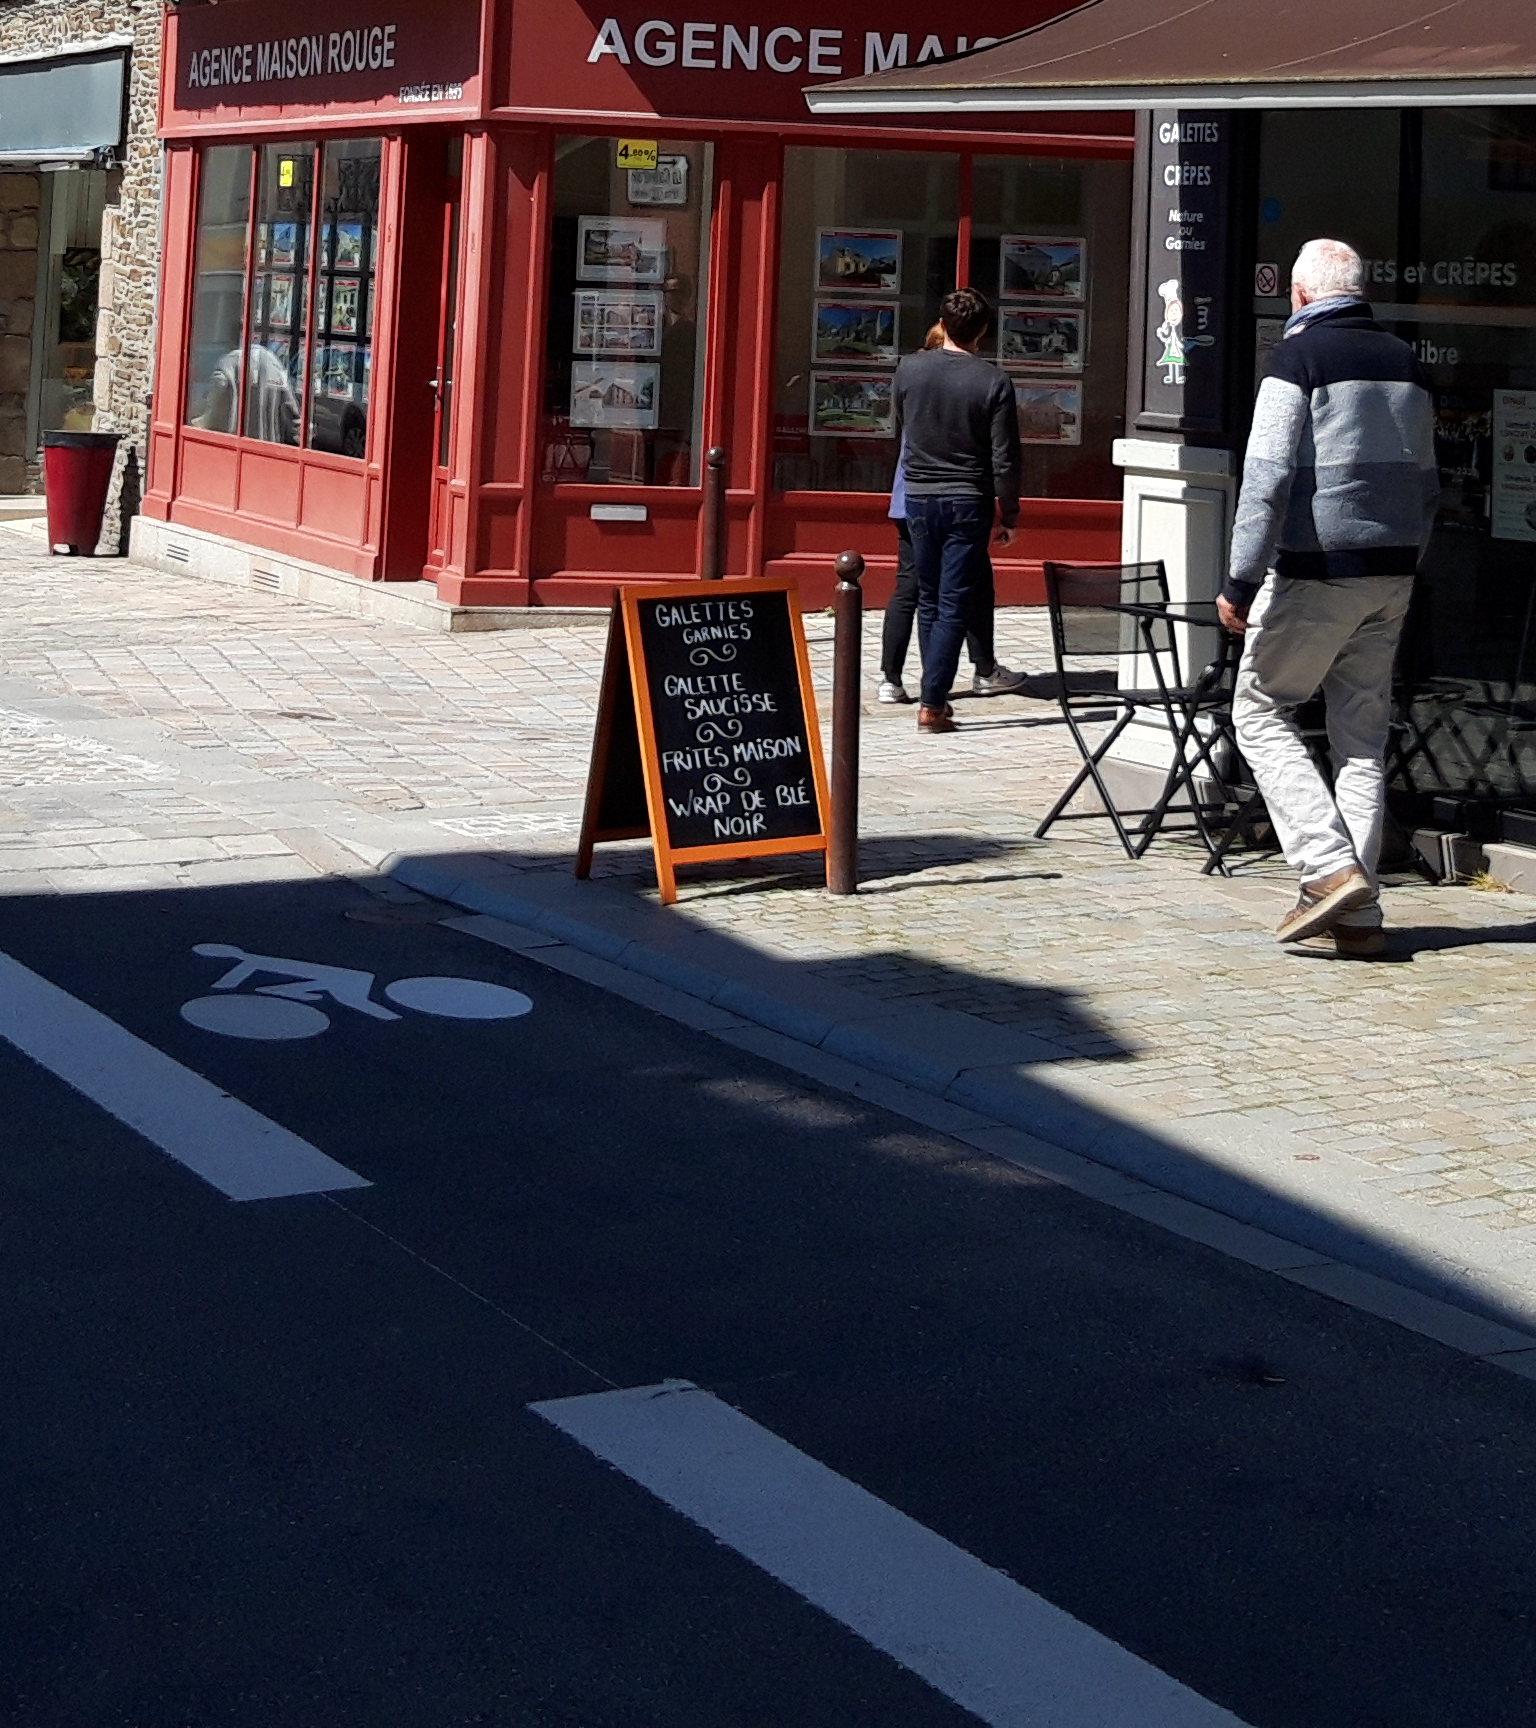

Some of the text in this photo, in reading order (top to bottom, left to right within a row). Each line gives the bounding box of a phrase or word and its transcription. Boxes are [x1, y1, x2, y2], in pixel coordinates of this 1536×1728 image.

[188, 24, 397, 89] AGENCE MAISON ROUGE
[586, 17, 1001, 75] AGENCE MA
[1159, 122, 1219, 144] GALETTES
[1163, 160, 1212, 186] CRÊPES
[1168, 209, 1204, 223] Nature
[1165, 236, 1205, 250] Garnies
[1404, 262, 1427, 284] et
[1432, 256, 1518, 288] CRÊPES
[655, 600, 754, 627] GALETTES
[682, 622, 752, 645] GARNIES
[663, 672, 747, 697] GALETTE
[683, 692, 778, 721] SAUCISSE
[661, 735, 803, 774] FRITES MAISON
[668, 777, 811, 818] WRAP DE BLÉ
[713, 812, 768, 838] NOIR
